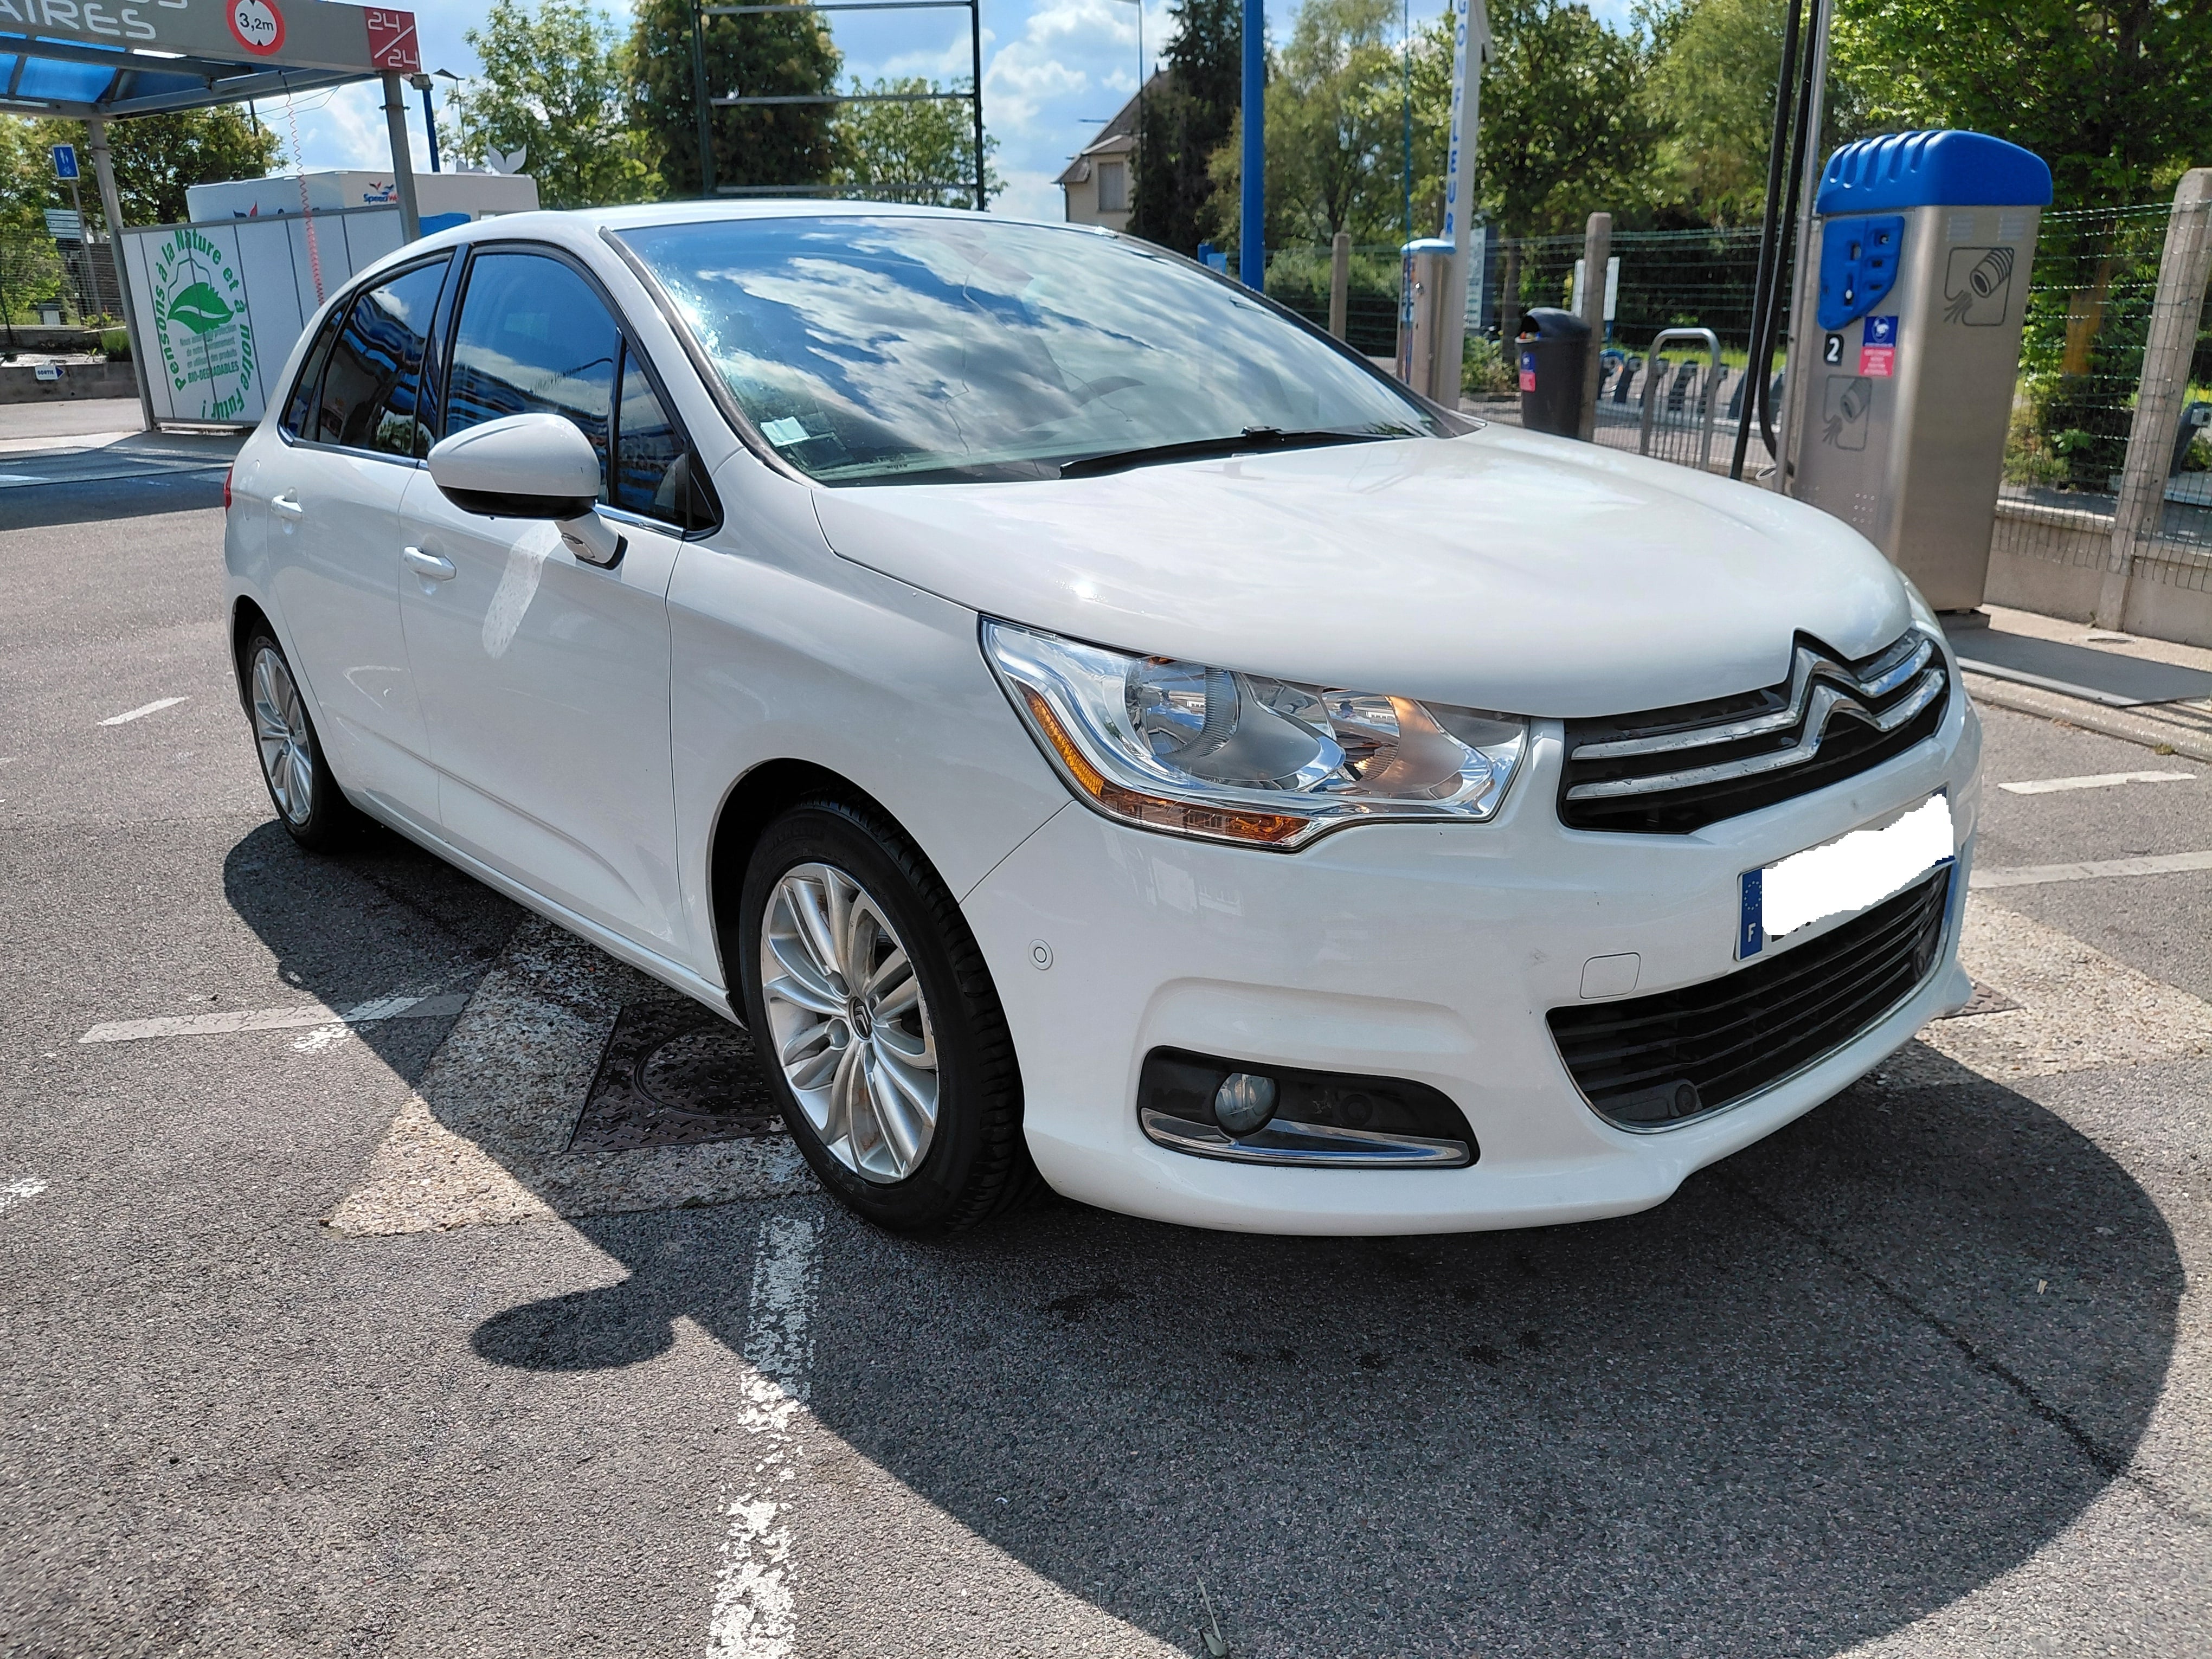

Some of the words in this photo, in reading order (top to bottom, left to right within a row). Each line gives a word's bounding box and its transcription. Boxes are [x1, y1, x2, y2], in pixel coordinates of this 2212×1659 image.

[239, 12, 274, 32] 3,2m
[162, 242, 175, 267] la
[174, 228, 221, 265] Nature
[223, 267, 239, 292] et
[155, 285, 187, 392] Pensons
[1827, 337, 1840, 362] 2
[240, 324, 254, 391] notre
[188, 361, 240, 383] BIO-DEGADABLES
[211, 387, 245, 420] Futur
[1747, 922, 1756, 943] F
